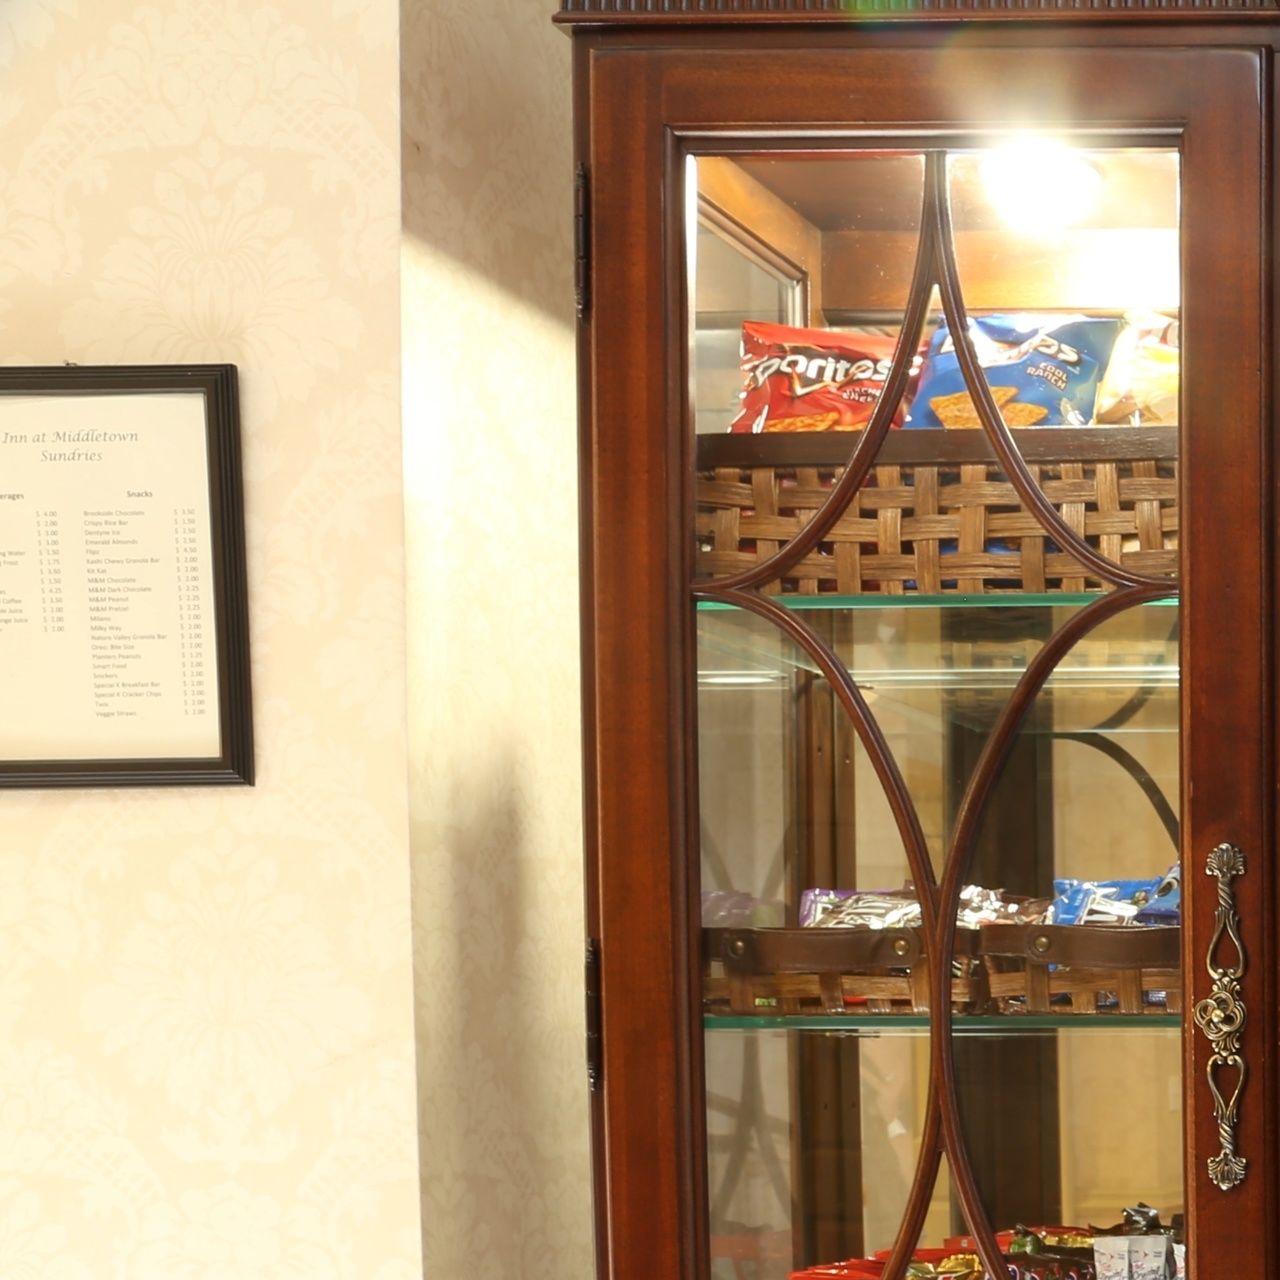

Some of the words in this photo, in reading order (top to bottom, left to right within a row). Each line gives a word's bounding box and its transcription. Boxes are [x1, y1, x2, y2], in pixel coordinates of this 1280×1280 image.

[1027, 366, 1067, 390] RANCH
[1040, 362, 1068, 380] COOL
[2, 432, 27, 444] Inn
[32, 432, 46, 443] at
[52, 429, 139, 443] Middletown
[40, 448, 103, 463] Sundries
[126, 490, 153, 498] Snacks
